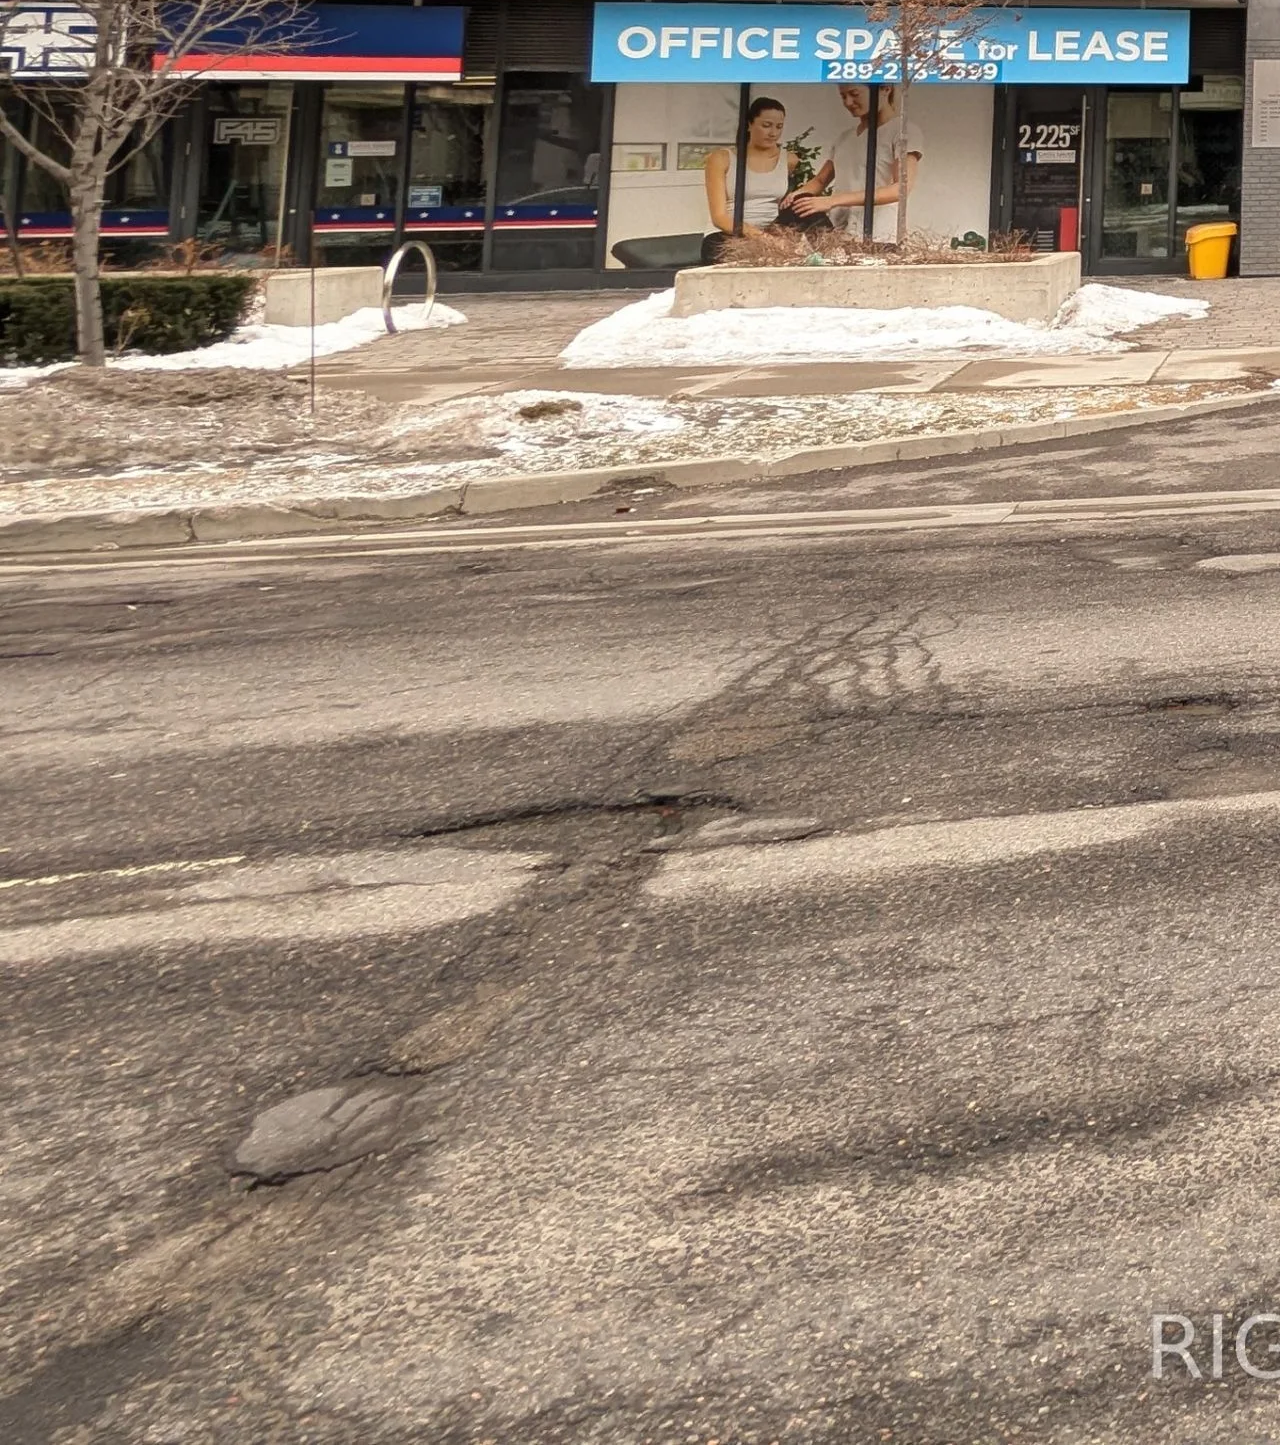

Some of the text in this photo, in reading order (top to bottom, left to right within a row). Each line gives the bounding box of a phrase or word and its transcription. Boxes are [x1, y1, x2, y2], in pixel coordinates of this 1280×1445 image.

[618, 26, 800, 59] OFFICE
[978, 38, 1018, 61] for
[1028, 30, 1169, 62] LEASE
[217, 120, 279, 143] F45
